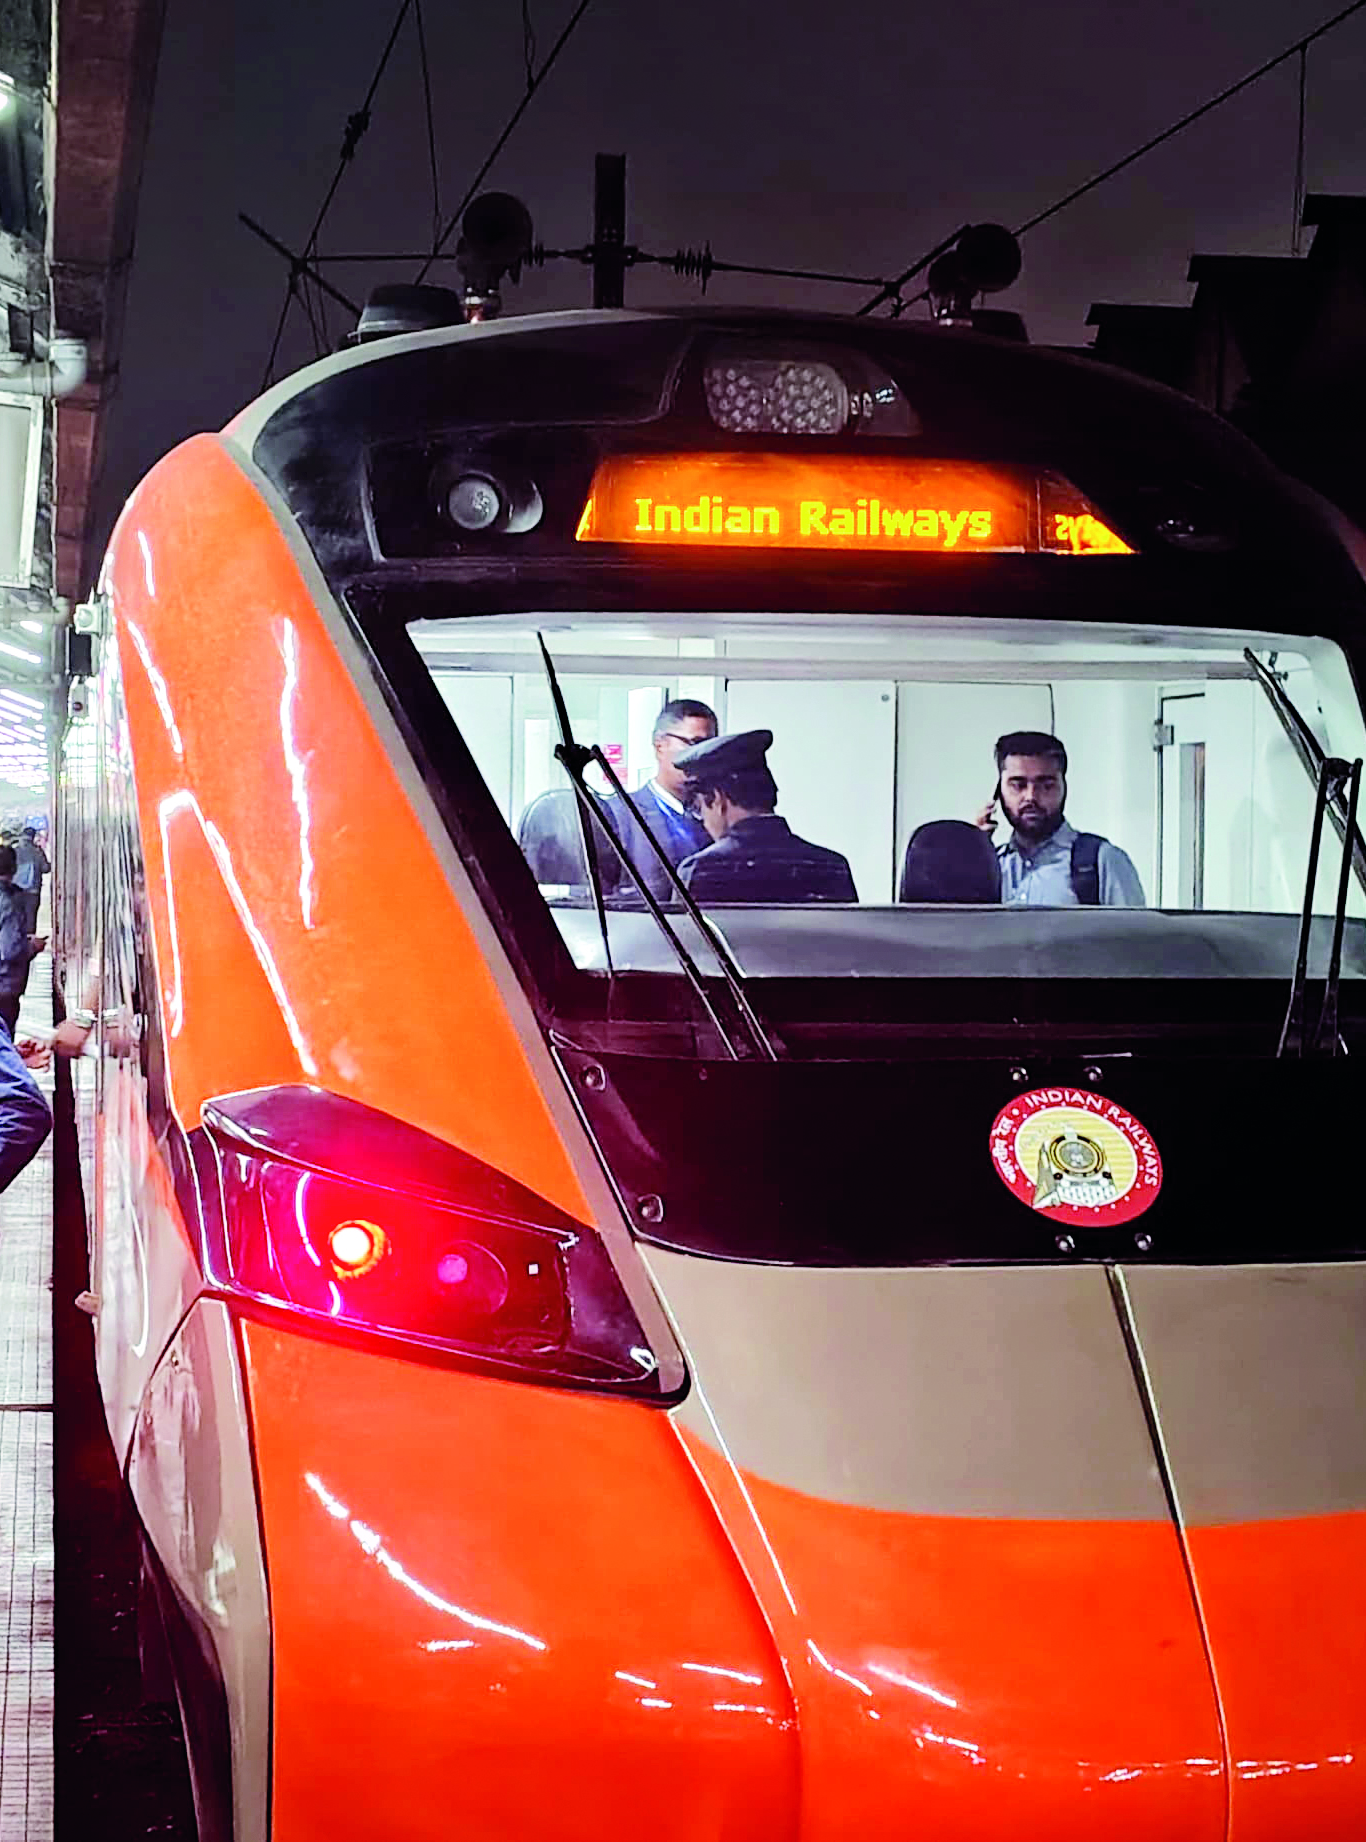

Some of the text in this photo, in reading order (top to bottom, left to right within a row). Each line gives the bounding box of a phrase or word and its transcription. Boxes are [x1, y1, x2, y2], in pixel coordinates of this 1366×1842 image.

[634, 496, 992, 547] Indian Railways
[992, 1138, 1016, 1184] भारतीय
[1024, 1090, 1158, 1187] INDIAN RAILWAYS
